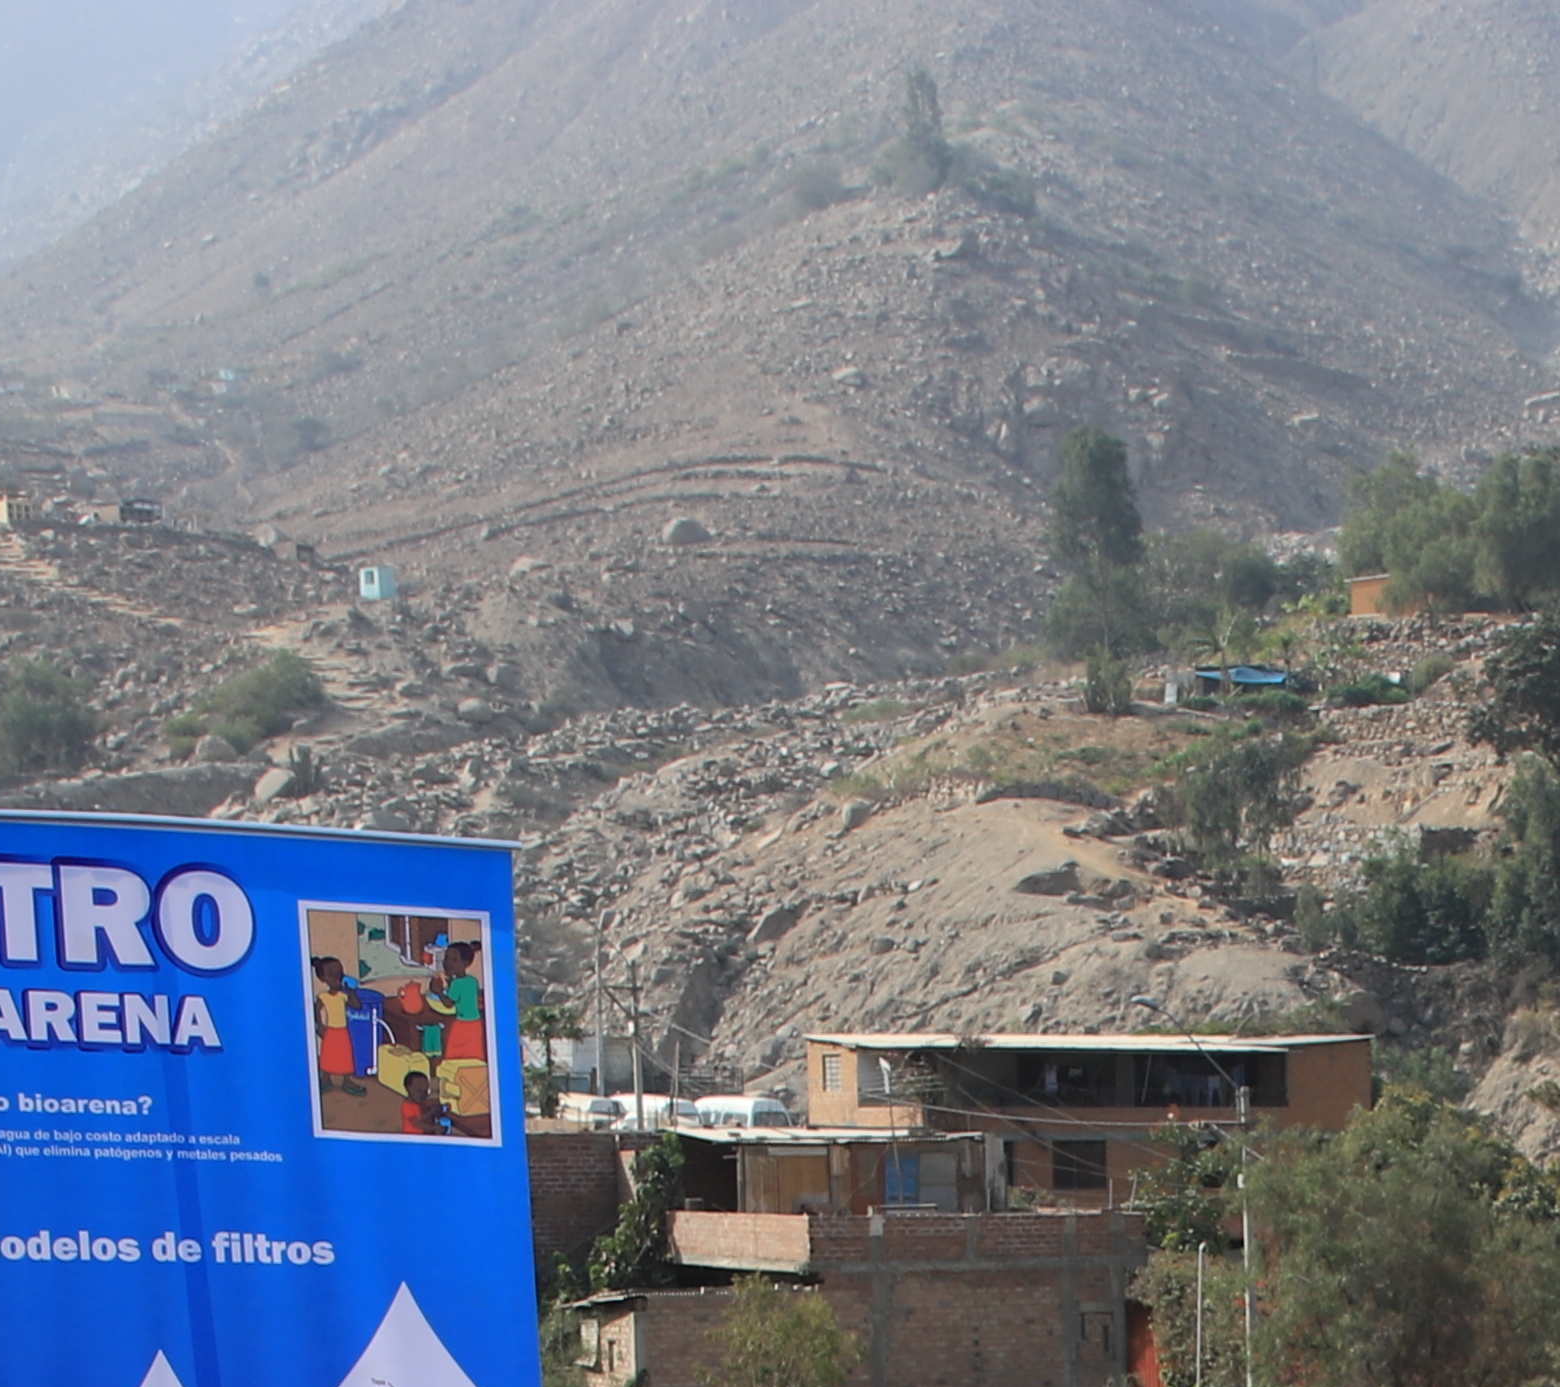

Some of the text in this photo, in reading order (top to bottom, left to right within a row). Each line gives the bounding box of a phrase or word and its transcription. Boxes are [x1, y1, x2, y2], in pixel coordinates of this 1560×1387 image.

[17, 1092, 152, 1115] bioarena?
[33, 1128, 50, 1140] de
[53, 1129, 82, 1143] bajo
[84, 1130, 122, 1142] costo
[124, 1131, 185, 1145] adaptado
[188, 1134, 196, 1144] a
[198, 1133, 240, 1145] escala
[14, 1145, 40, 1157] que
[42, 1144, 91, 1156] elimina
[93, 1146, 162, 1160] patógenos
[165, 1149, 173, 1161] y
[176, 1148, 226, 1160] metales
[229, 1150, 283, 1162] pesados
[151, 1230, 202, 1262] de
[211, 1230, 335, 1265] filtros
